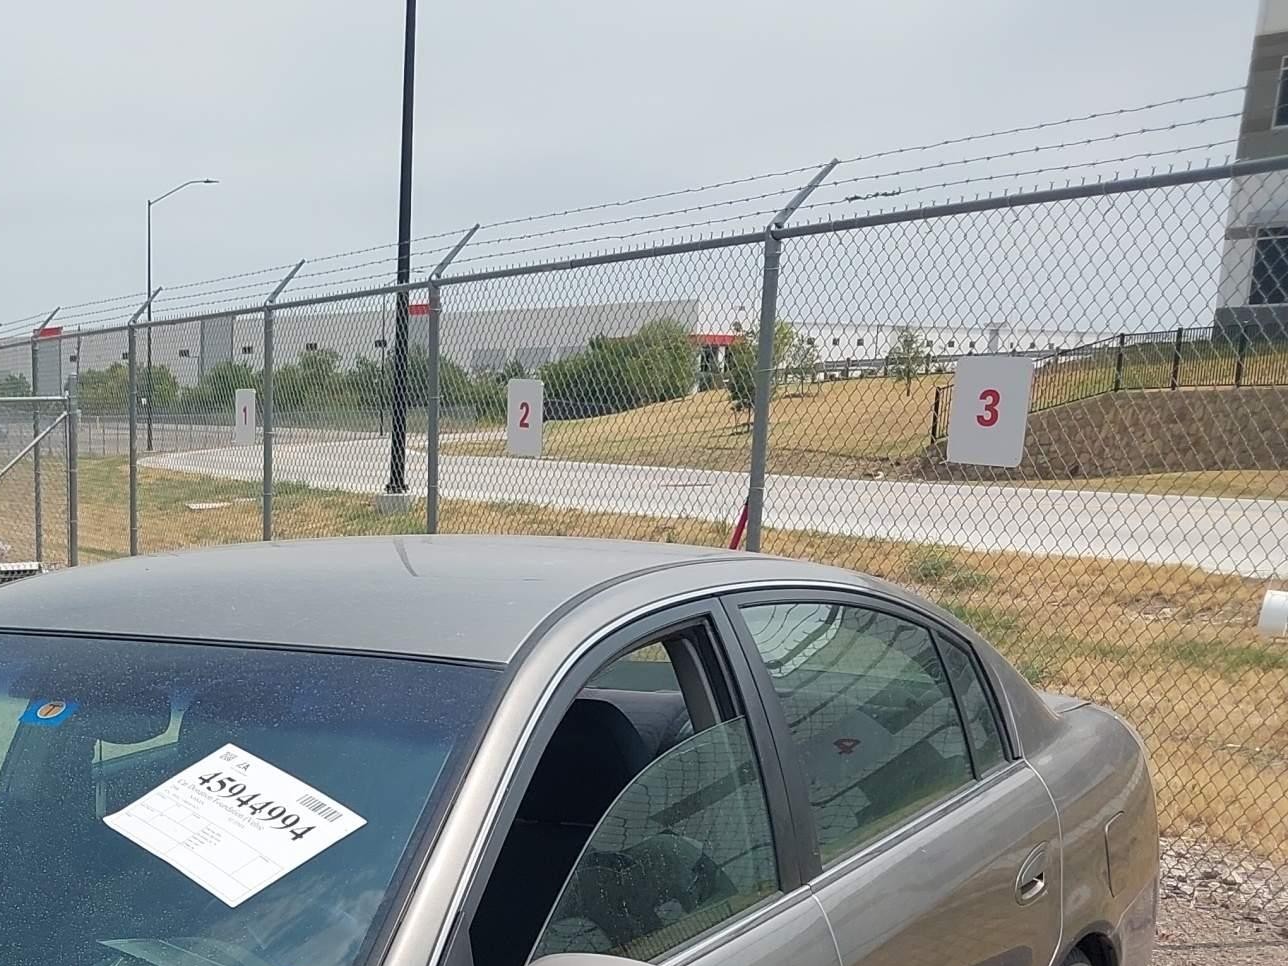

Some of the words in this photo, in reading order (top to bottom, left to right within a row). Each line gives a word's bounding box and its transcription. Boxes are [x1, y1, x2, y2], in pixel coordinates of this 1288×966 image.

[242, 405, 248, 425] 1
[518, 401, 530, 428] 2
[975, 388, 1001, 428] 3
[198, 771, 317, 841] 45944994
